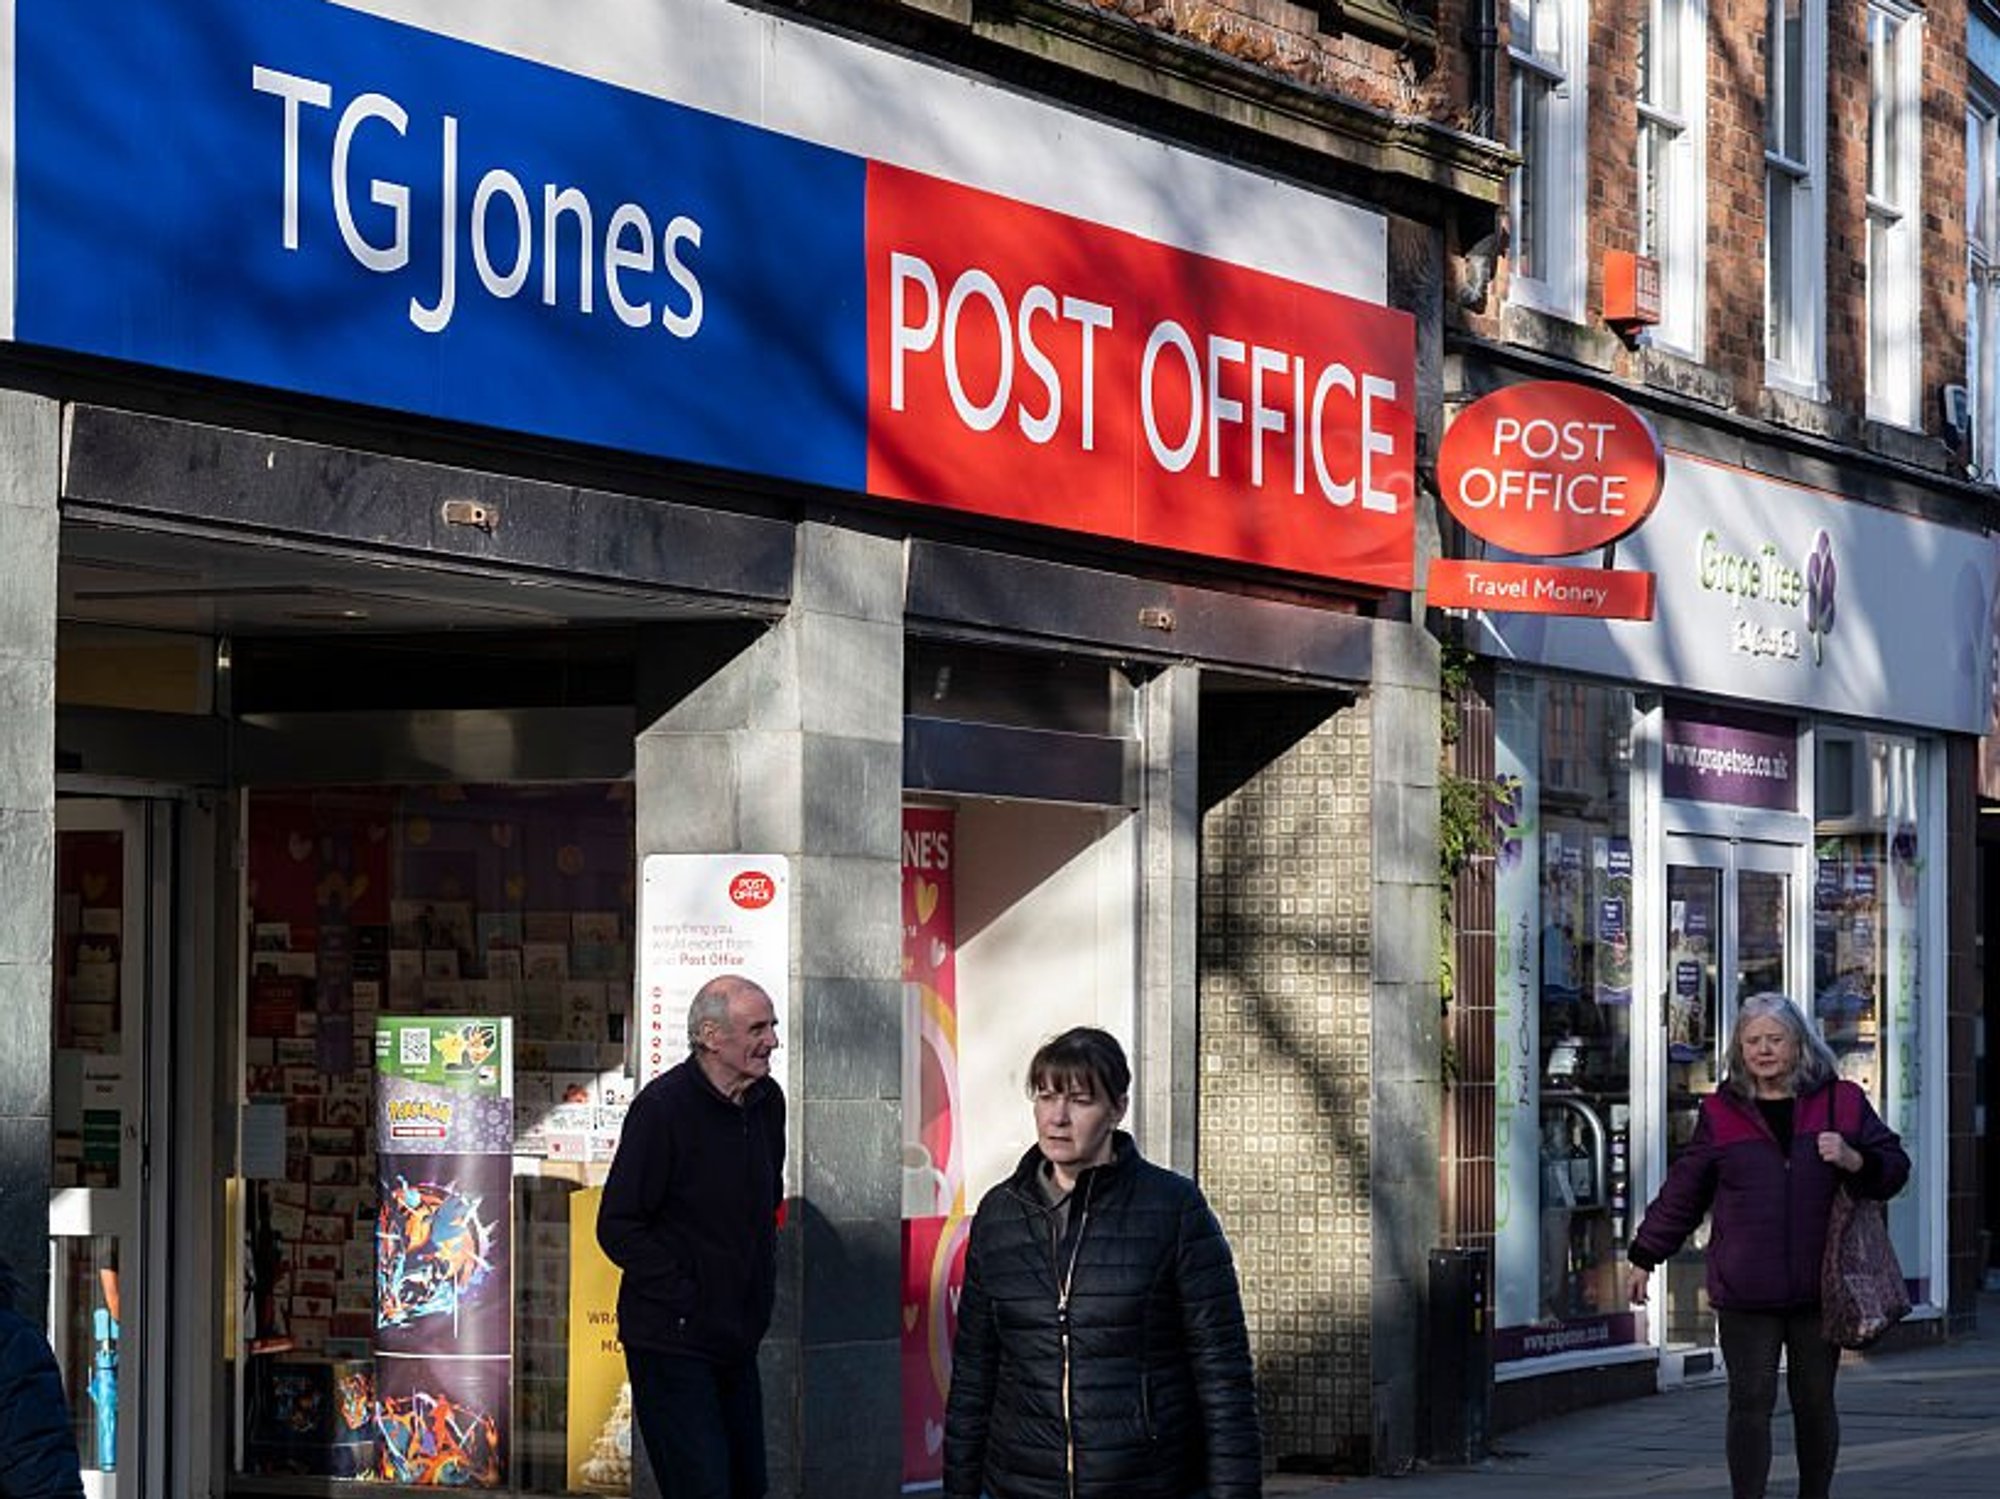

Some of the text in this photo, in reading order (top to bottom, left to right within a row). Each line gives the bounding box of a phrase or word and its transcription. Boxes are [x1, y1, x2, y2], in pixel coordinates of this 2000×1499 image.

[891, 251, 1397, 515] POST OFFICE
[1492, 417, 1616, 462] POST
[1459, 467, 1629, 516] OFFICE
[1466, 572, 1609, 608] Travel Money
[738, 878, 766, 890] POST
[680, 952, 706, 965] Post
[709, 952, 745, 966] Office
